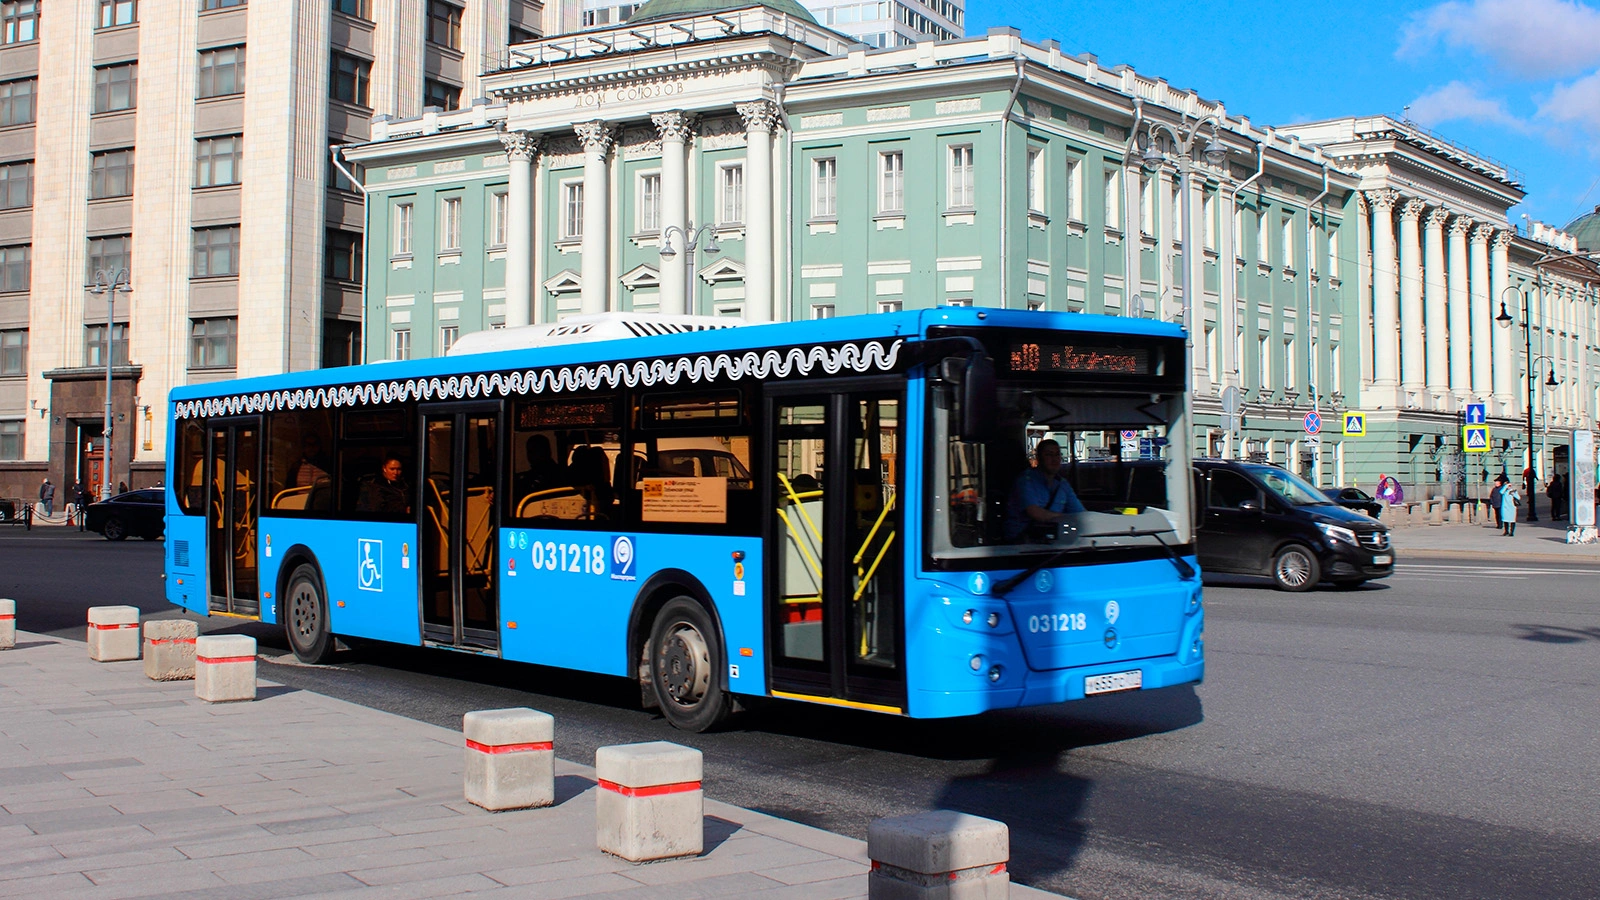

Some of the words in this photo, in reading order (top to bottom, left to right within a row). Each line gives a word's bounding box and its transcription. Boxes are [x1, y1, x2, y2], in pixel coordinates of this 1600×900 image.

[574, 93, 606, 108] ДОМ
[617, 82, 684, 102] СОЮЗОВ
[531, 540, 605, 575] 031218
[1029, 612, 1087, 633] 031218
